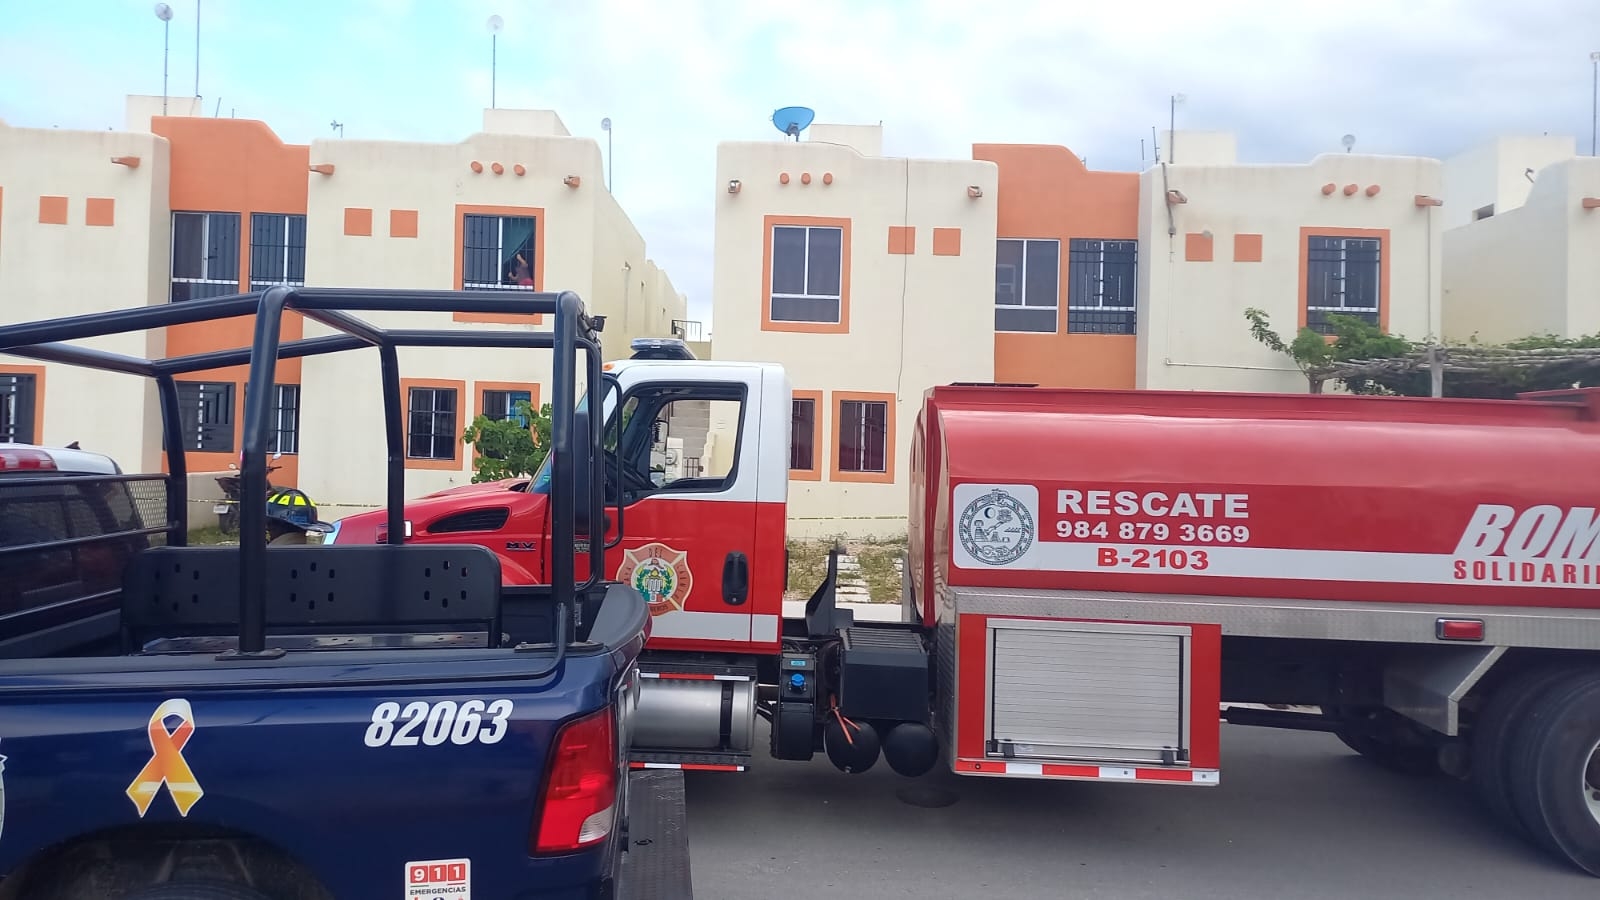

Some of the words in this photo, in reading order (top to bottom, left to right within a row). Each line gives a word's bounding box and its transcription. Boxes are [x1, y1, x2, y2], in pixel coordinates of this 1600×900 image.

[1057, 489, 1249, 518] RESCATE
[1056, 520, 1109, 538] 984
[1119, 522, 1170, 540] 879
[1179, 524, 1250, 543] 3669
[1453, 504, 1600, 559] BOM
[1097, 547, 1209, 570] B-2103
[1454, 560, 1600, 585] SOLIDARI
[364, 699, 514, 747] 82063
[414, 866, 461, 882] 911
[410, 886, 467, 895] EMERGENCIAS
